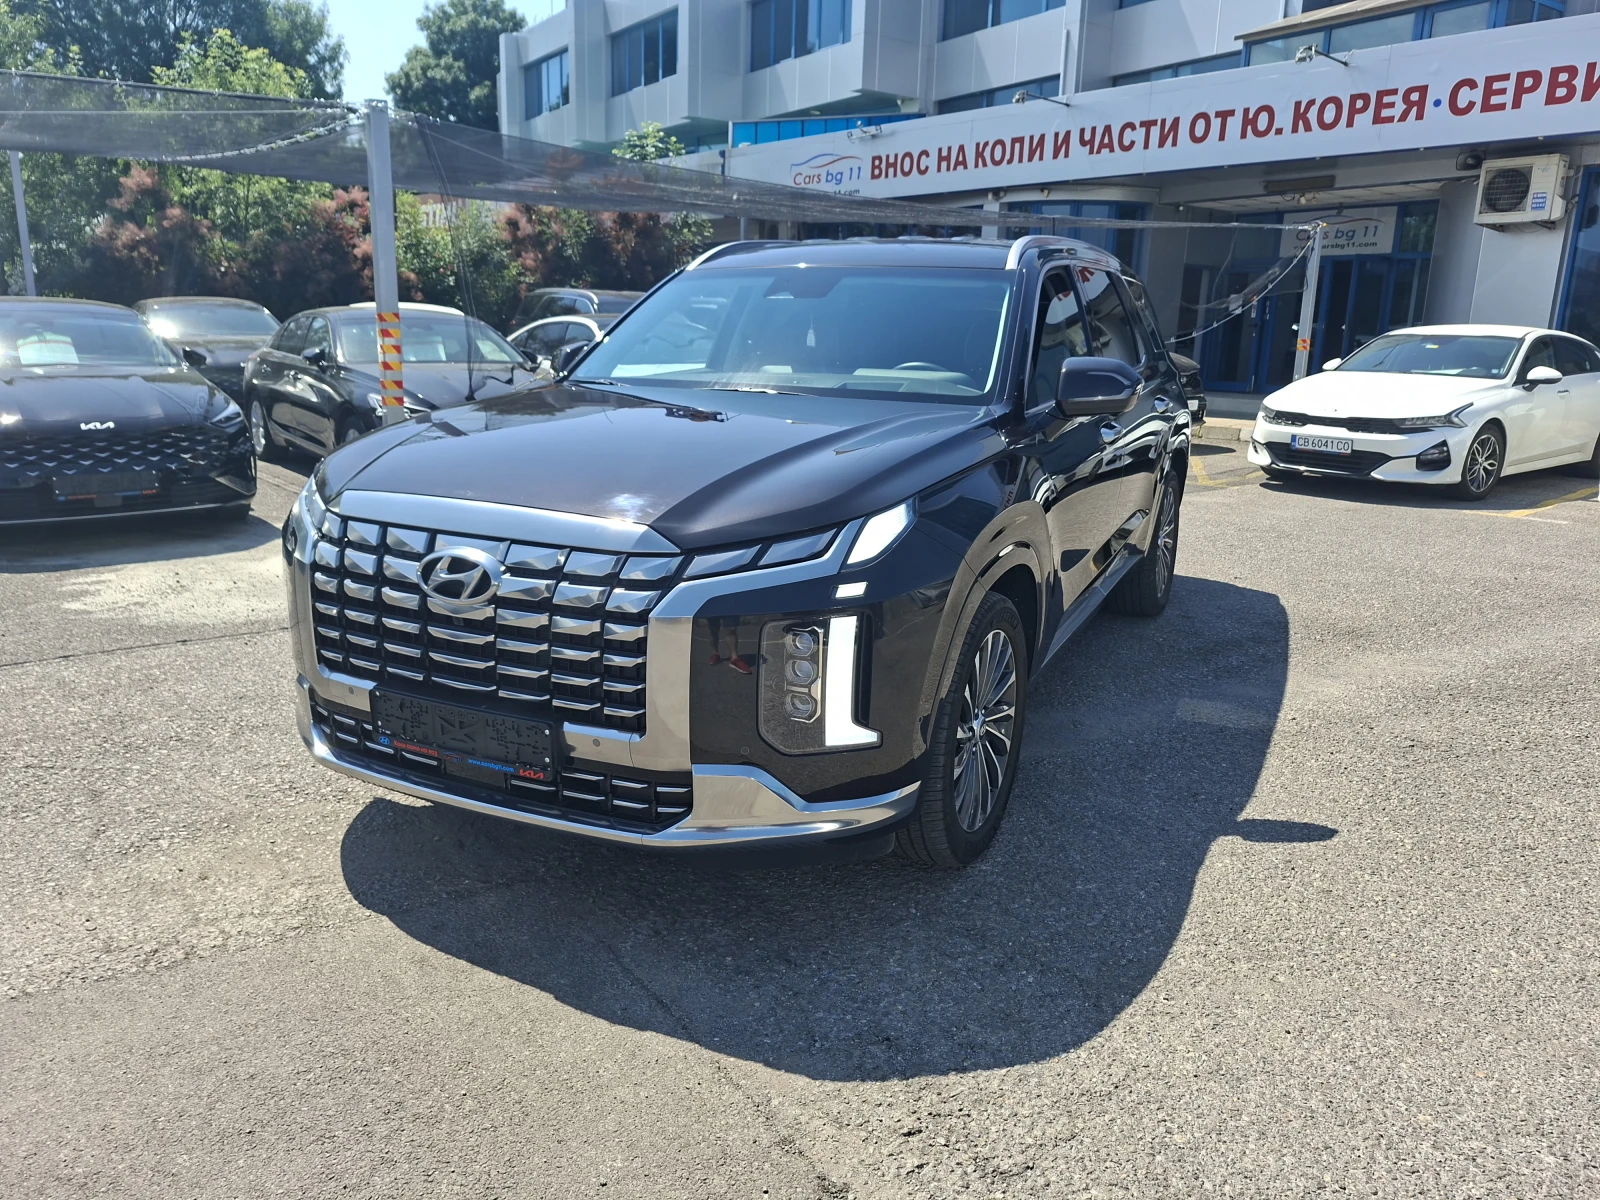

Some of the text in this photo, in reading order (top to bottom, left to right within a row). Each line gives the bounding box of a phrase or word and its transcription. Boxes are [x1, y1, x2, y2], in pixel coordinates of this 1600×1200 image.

[870, 149, 930, 180] ВНОС
[936, 144, 969, 173] НА
[974, 133, 1046, 169] КОЛИ
[1052, 129, 1071, 160] И
[1078, 116, 1181, 156] ЧАСТИ
[1188, 109, 1236, 144] ОТ
[1240, 104, 1284, 140] Ю.
[1290, 84, 1429, 134] КОРЕЯ
[793, 166, 862, 187] Cars bg 11
[1296, 225, 1379, 241] Cs bg 11
[80, 421, 115, 430] KIA
[1297, 436, 1310, 447] CB
[1311, 438, 1334, 449] 6041
[1336, 441, 1350, 451] CO
[519, 768, 545, 779] KIA
